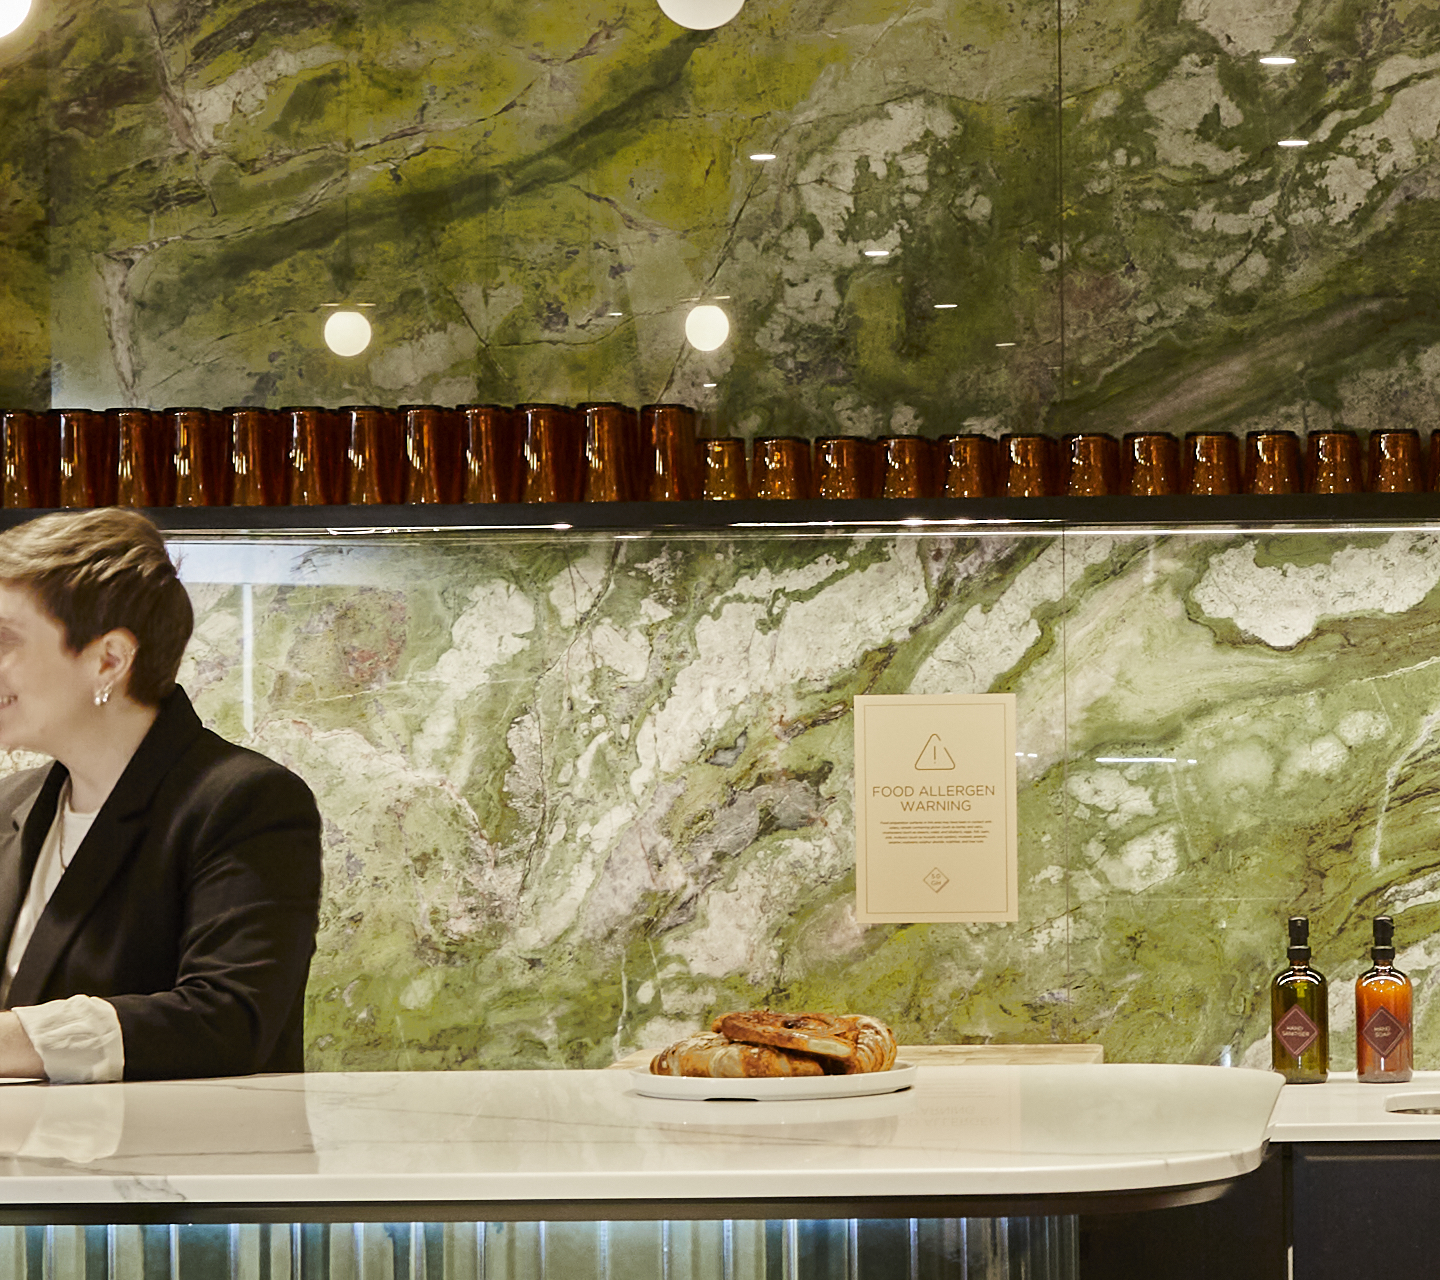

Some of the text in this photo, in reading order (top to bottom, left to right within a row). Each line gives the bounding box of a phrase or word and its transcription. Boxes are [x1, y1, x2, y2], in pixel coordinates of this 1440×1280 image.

[873, 785, 995, 797] FOOD ALLERGEN
[901, 800, 971, 811] WARNING
